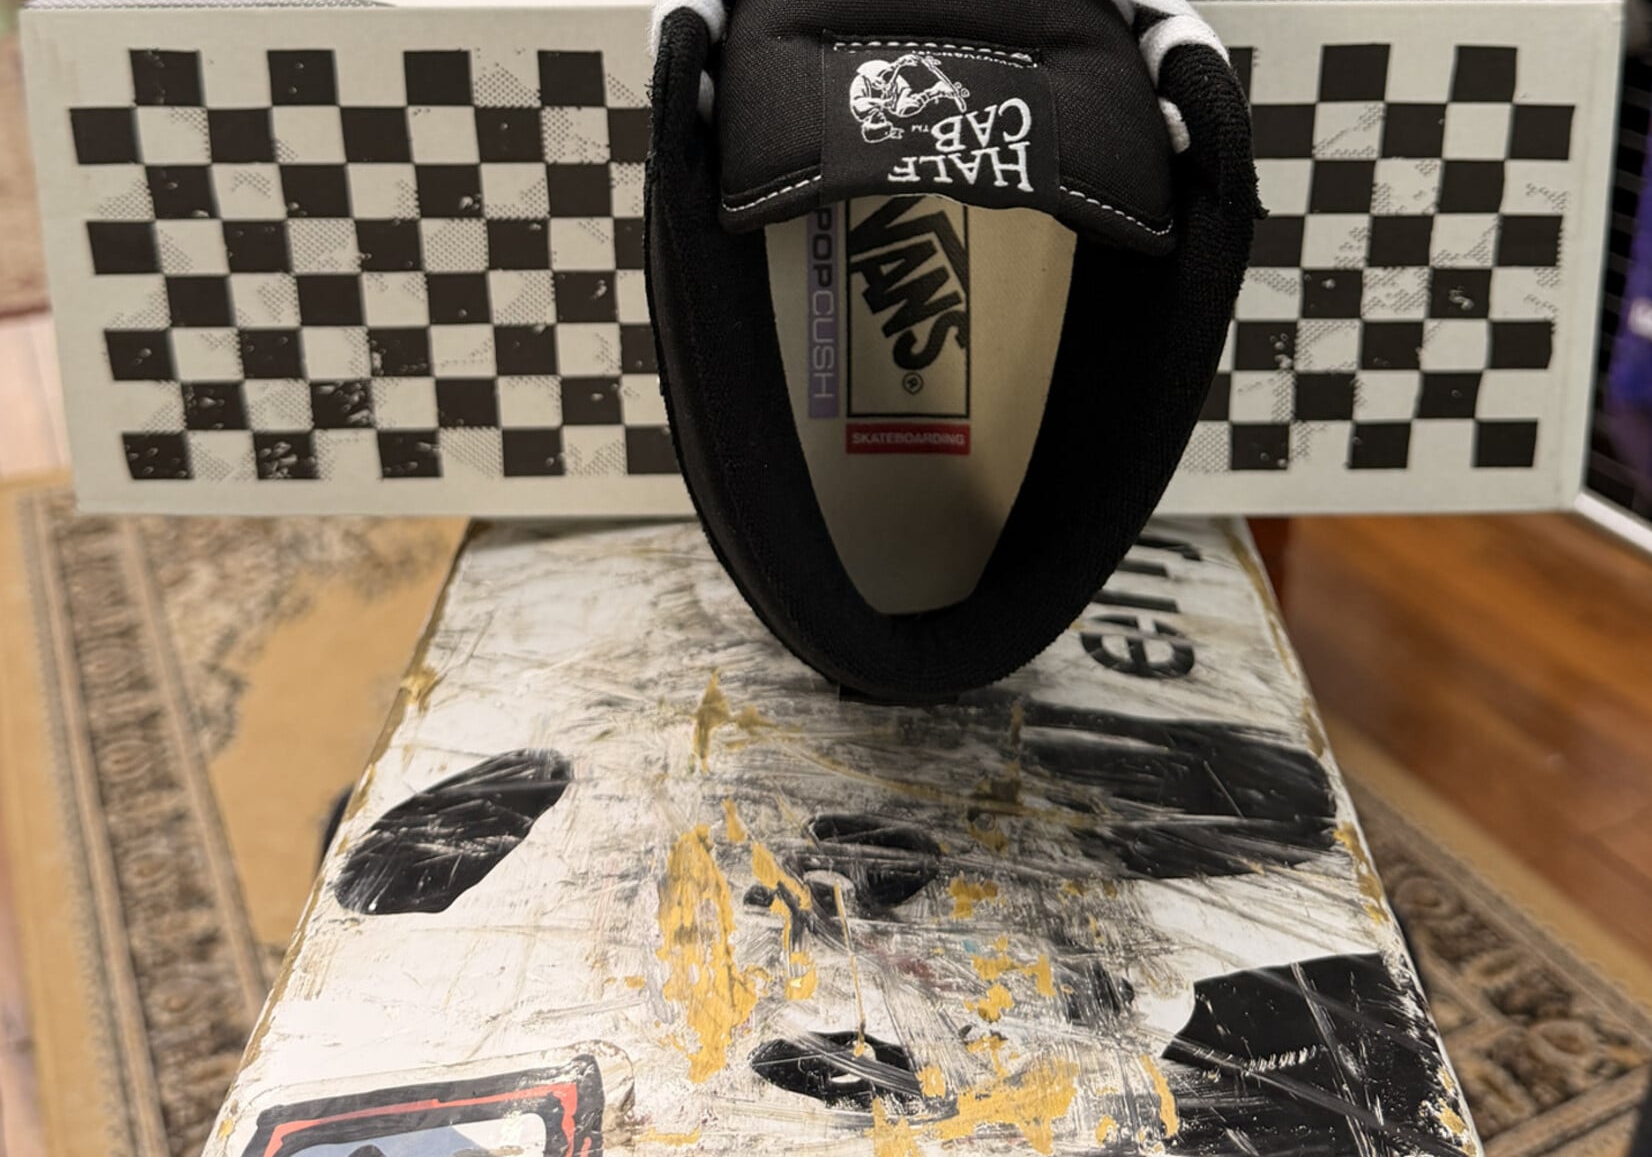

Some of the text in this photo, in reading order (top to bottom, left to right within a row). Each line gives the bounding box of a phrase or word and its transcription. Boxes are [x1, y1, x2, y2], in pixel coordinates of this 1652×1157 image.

[929, 97, 1032, 153] CAB
[888, 141, 1034, 192] HALF
[812, 206, 835, 398] POPCUSH
[850, 195, 969, 371] VANS
[851, 431, 966, 446] SKATEBOARDING
